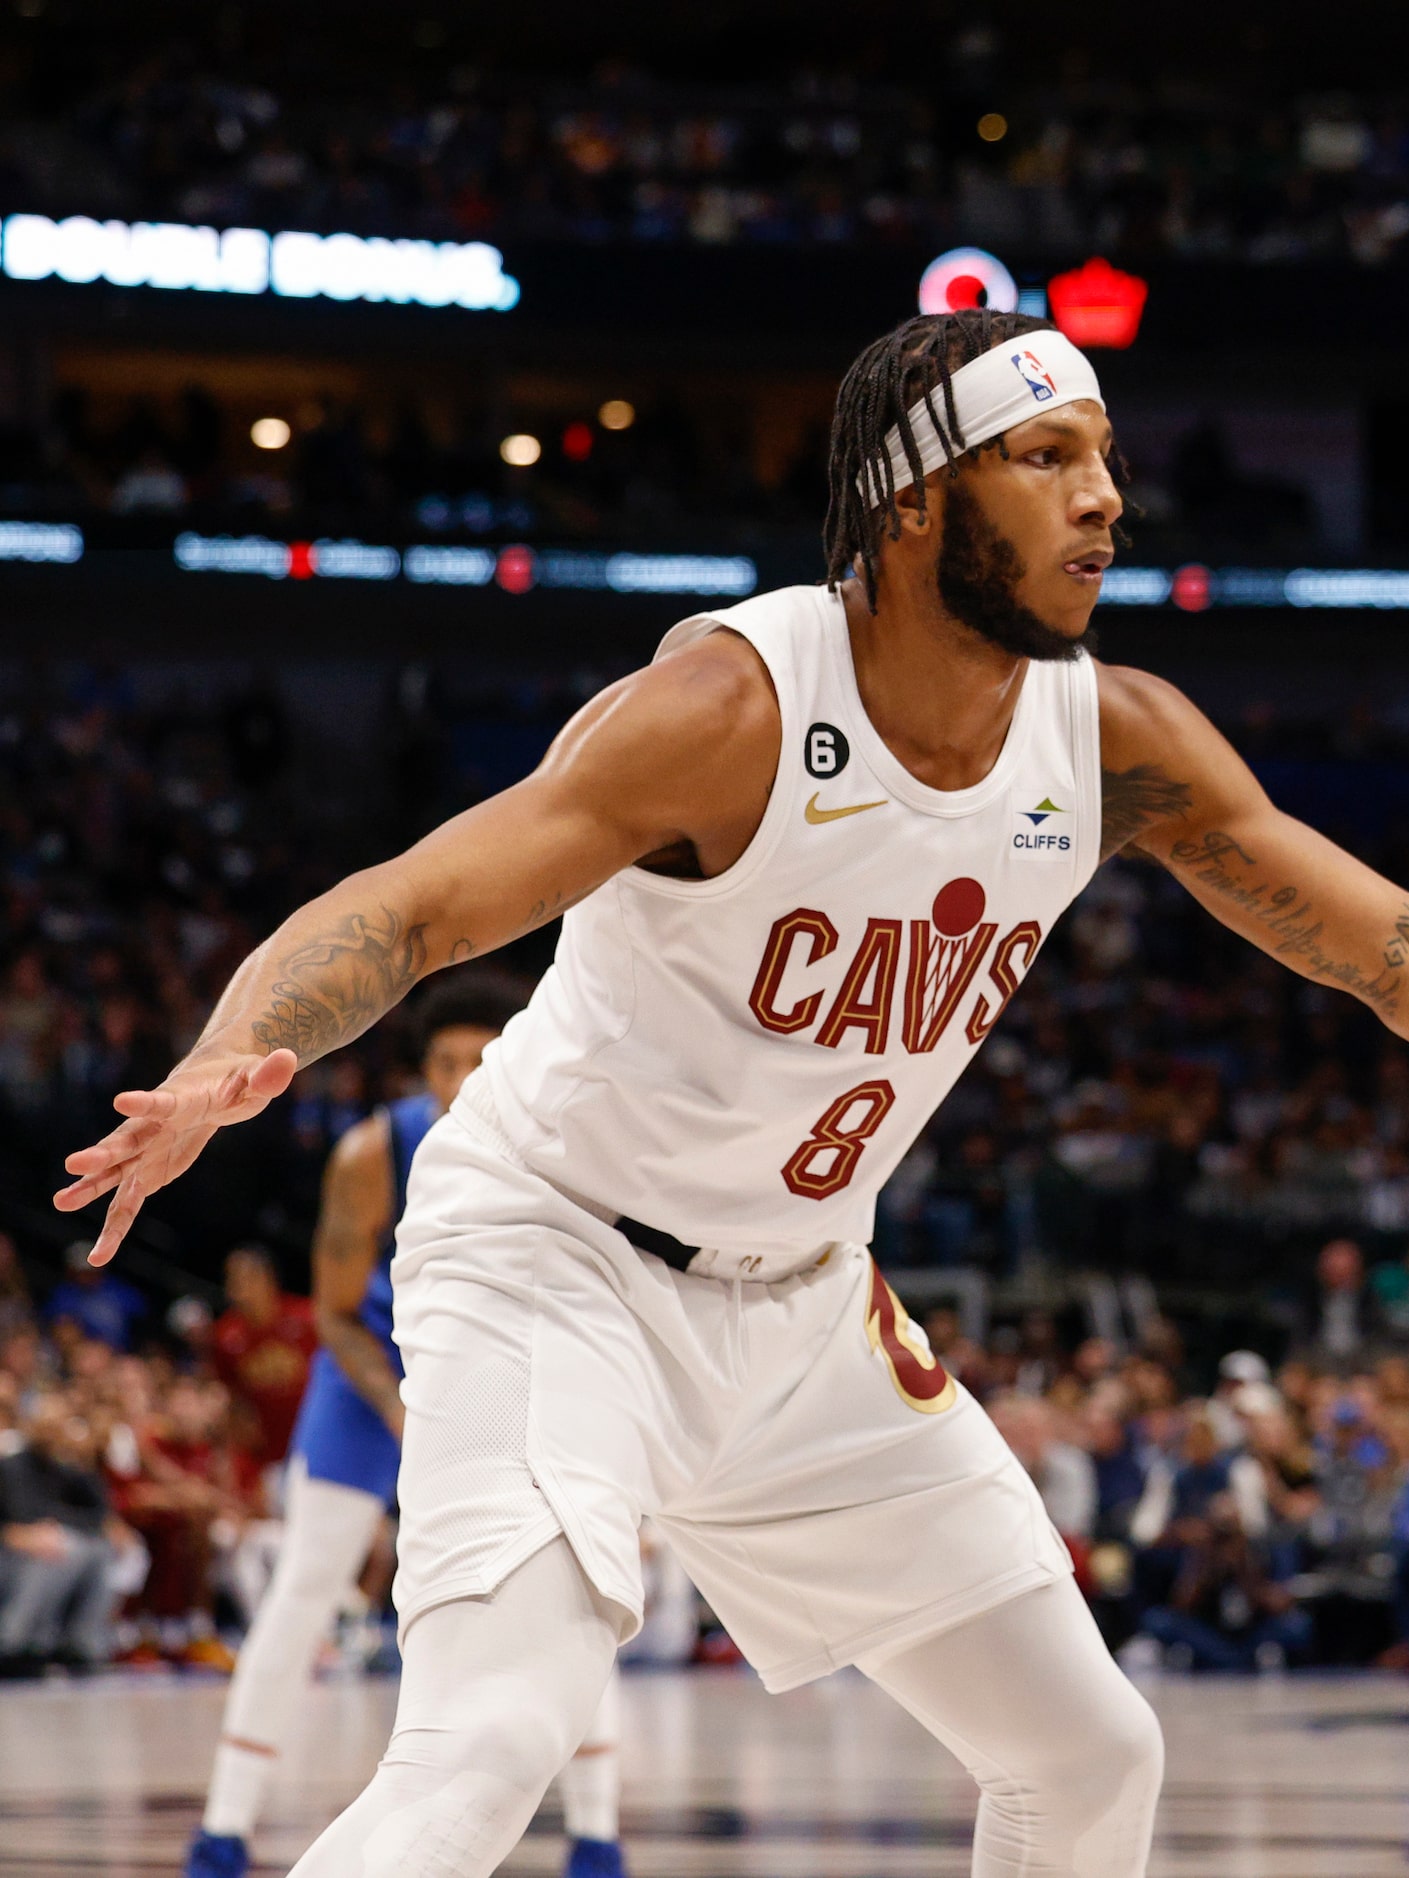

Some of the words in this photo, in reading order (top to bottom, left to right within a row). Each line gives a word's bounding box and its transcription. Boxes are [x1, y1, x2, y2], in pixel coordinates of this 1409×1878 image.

[810, 730, 837, 772] 6
[1012, 832, 1072, 852] CLIFFS
[748, 906, 1043, 1055] CAVS
[780, 1078, 895, 1202] 8
